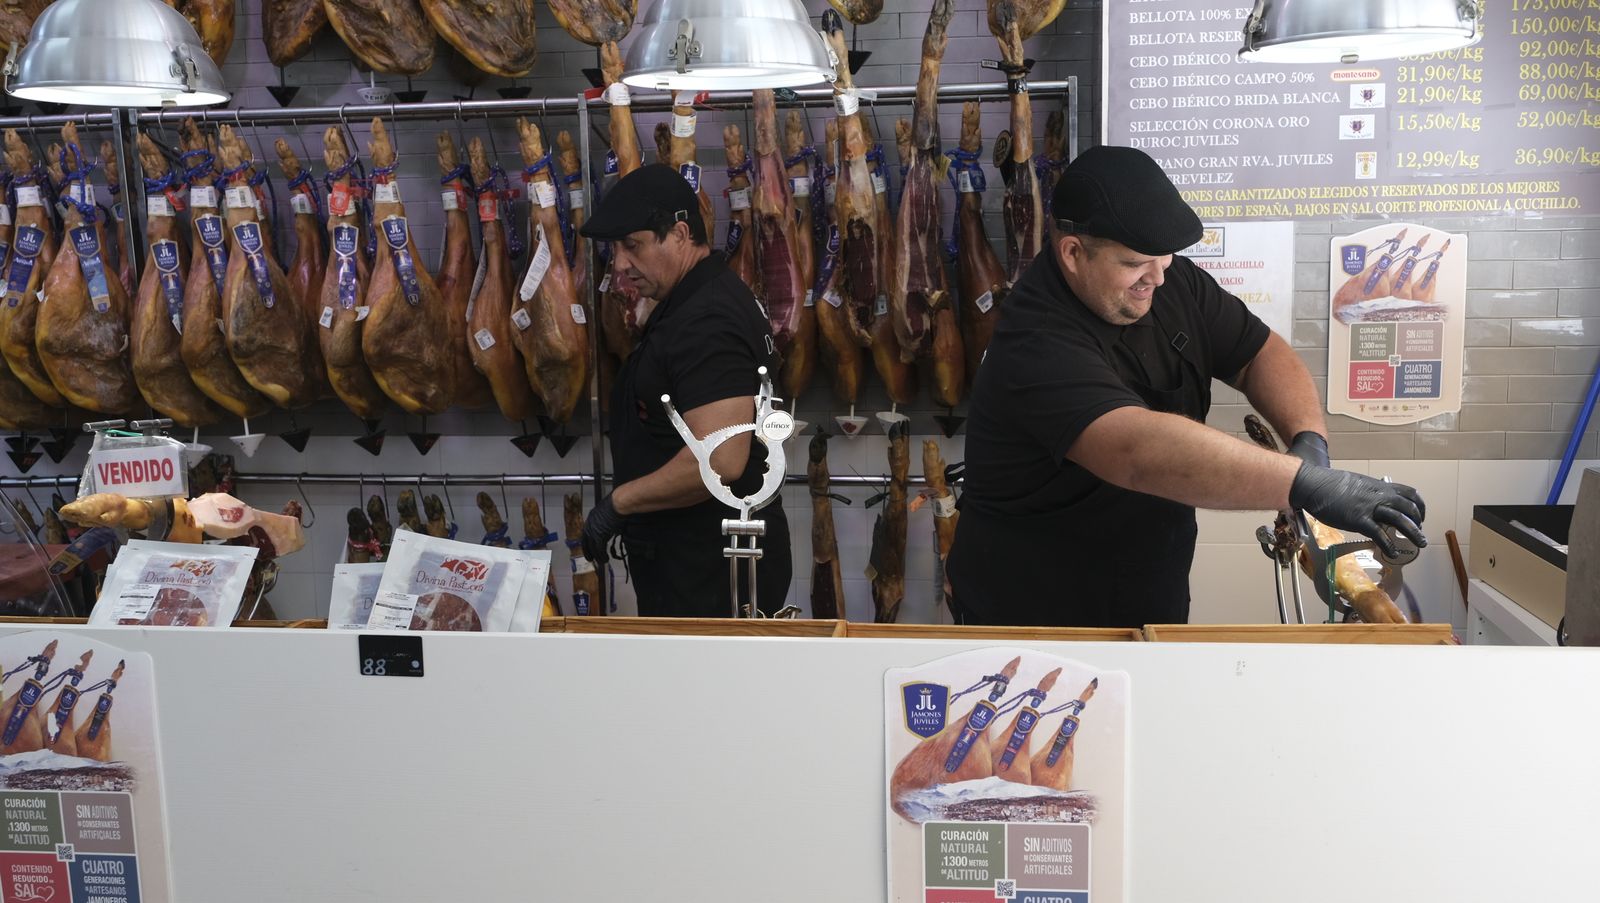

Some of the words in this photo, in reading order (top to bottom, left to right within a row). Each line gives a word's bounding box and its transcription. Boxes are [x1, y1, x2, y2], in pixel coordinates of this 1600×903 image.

[1511, 0, 1600, 12] 175,00€/k
[1129, 10, 1196, 24] BELLOTA
[1200, 9, 1232, 21] 100%
[1235, 8, 1253, 20] EX
[1511, 15, 1600, 36] 150,00€/k
[1129, 32, 1196, 46] BELLOTA
[1199, 30, 1243, 43] RESER
[1129, 55, 1169, 68] CEBO
[1172, 52, 1231, 66] IBÉRICO
[1398, 47, 1484, 63] ,0€/kg
[1129, 76, 1169, 89] CEBO
[1172, 72, 1231, 87] IBÉRICO
[1234, 73, 1286, 86] CAMPO
[1289, 72, 1315, 83] 50%
[1333, 70, 1378, 79] montesano
[1397, 63, 1483, 84] 31,90€/kg
[1129, 97, 1168, 110] CEBO
[1172, 93, 1231, 108] IBÉRICO
[1234, 94, 1280, 106] BRIDA
[1283, 92, 1341, 104] BLANCA
[1397, 84, 1482, 106] 21,90€/kg
[1129, 117, 1208, 133] SELECCIÓN
[1212, 117, 1274, 130] CORONA
[1278, 116, 1310, 128] ORO
[1397, 113, 1482, 134] 15,50€/kg
[1130, 136, 1181, 149] DUROC
[1182, 134, 1239, 148] JUVILES
[1155, 157, 1195, 170] RANO
[1198, 156, 1239, 168] GRAN
[1242, 155, 1274, 167] RVA.
[1275, 153, 1334, 168] JUVILES
[1396, 150, 1480, 169] 12,99€/kg
[1515, 146, 1600, 167] 36,90€/kg
[1180, 190, 1213, 202] ONES
[1215, 187, 1307, 202] GARANTIZADOS
[1309, 185, 1368, 199] ELEGIDOS
[1371, 185, 1380, 197] Y
[1381, 183, 1458, 197] RESERVADOS
[1461, 183, 1478, 195] DE
[1480, 182, 1504, 195] LOS
[1506, 181, 1560, 195] MEJORES
[1192, 205, 1224, 217] ORES
[1226, 205, 1243, 217] DE
[1245, 202, 1292, 217] ESPAÑA,
[1295, 203, 1330, 217] BAJOS
[1333, 202, 1349, 215] EN
[1351, 202, 1373, 214] SAL
[1376, 201, 1416, 213] CORTE
[1419, 199, 1501, 212] PROFESIONAL
[1503, 199, 1512, 210] A
[1514, 197, 1581, 210] CUCHILLO.
[1195, 261, 1214, 269] ORTE
[1223, 261, 1265, 269] CUCHILLO
[1404, 364, 1433, 374] CUATRO
[765, 422, 790, 430] afinox
[98, 457, 174, 486] VENDIDO
[416, 570, 446, 587] Divina
[363, 658, 386, 675] 88
[911, 710, 942, 719] JAMONES
[913, 718, 940, 726] JUVILES
[4, 797, 46, 809] CURACIÓN
[5, 810, 47, 820] NATURAL
[76, 804, 91, 818] SIN
[14, 834, 50, 845] ALTITUD
[79, 830, 121, 840] ARTIFICIALES
[940, 828, 989, 841] CURACIÓN
[940, 843, 989, 854] NATURAL
[1024, 837, 1040, 852] SIN
[1041, 838, 1073, 853] ADITIVOS
[1029, 854, 1073, 863] CONSERVANTES
[11, 864, 53, 874] CONTENIDO
[82, 859, 125, 875] CUATRO
[1024, 864, 1073, 875] ARTIFICIALES
[12, 875, 49, 883] REDUCIDO
[83, 875, 126, 885] GENERACIONES
[946, 869, 989, 881] ALTITUD
[14, 883, 36, 897] SAL
[88, 885, 127, 896] ARTESANOS
